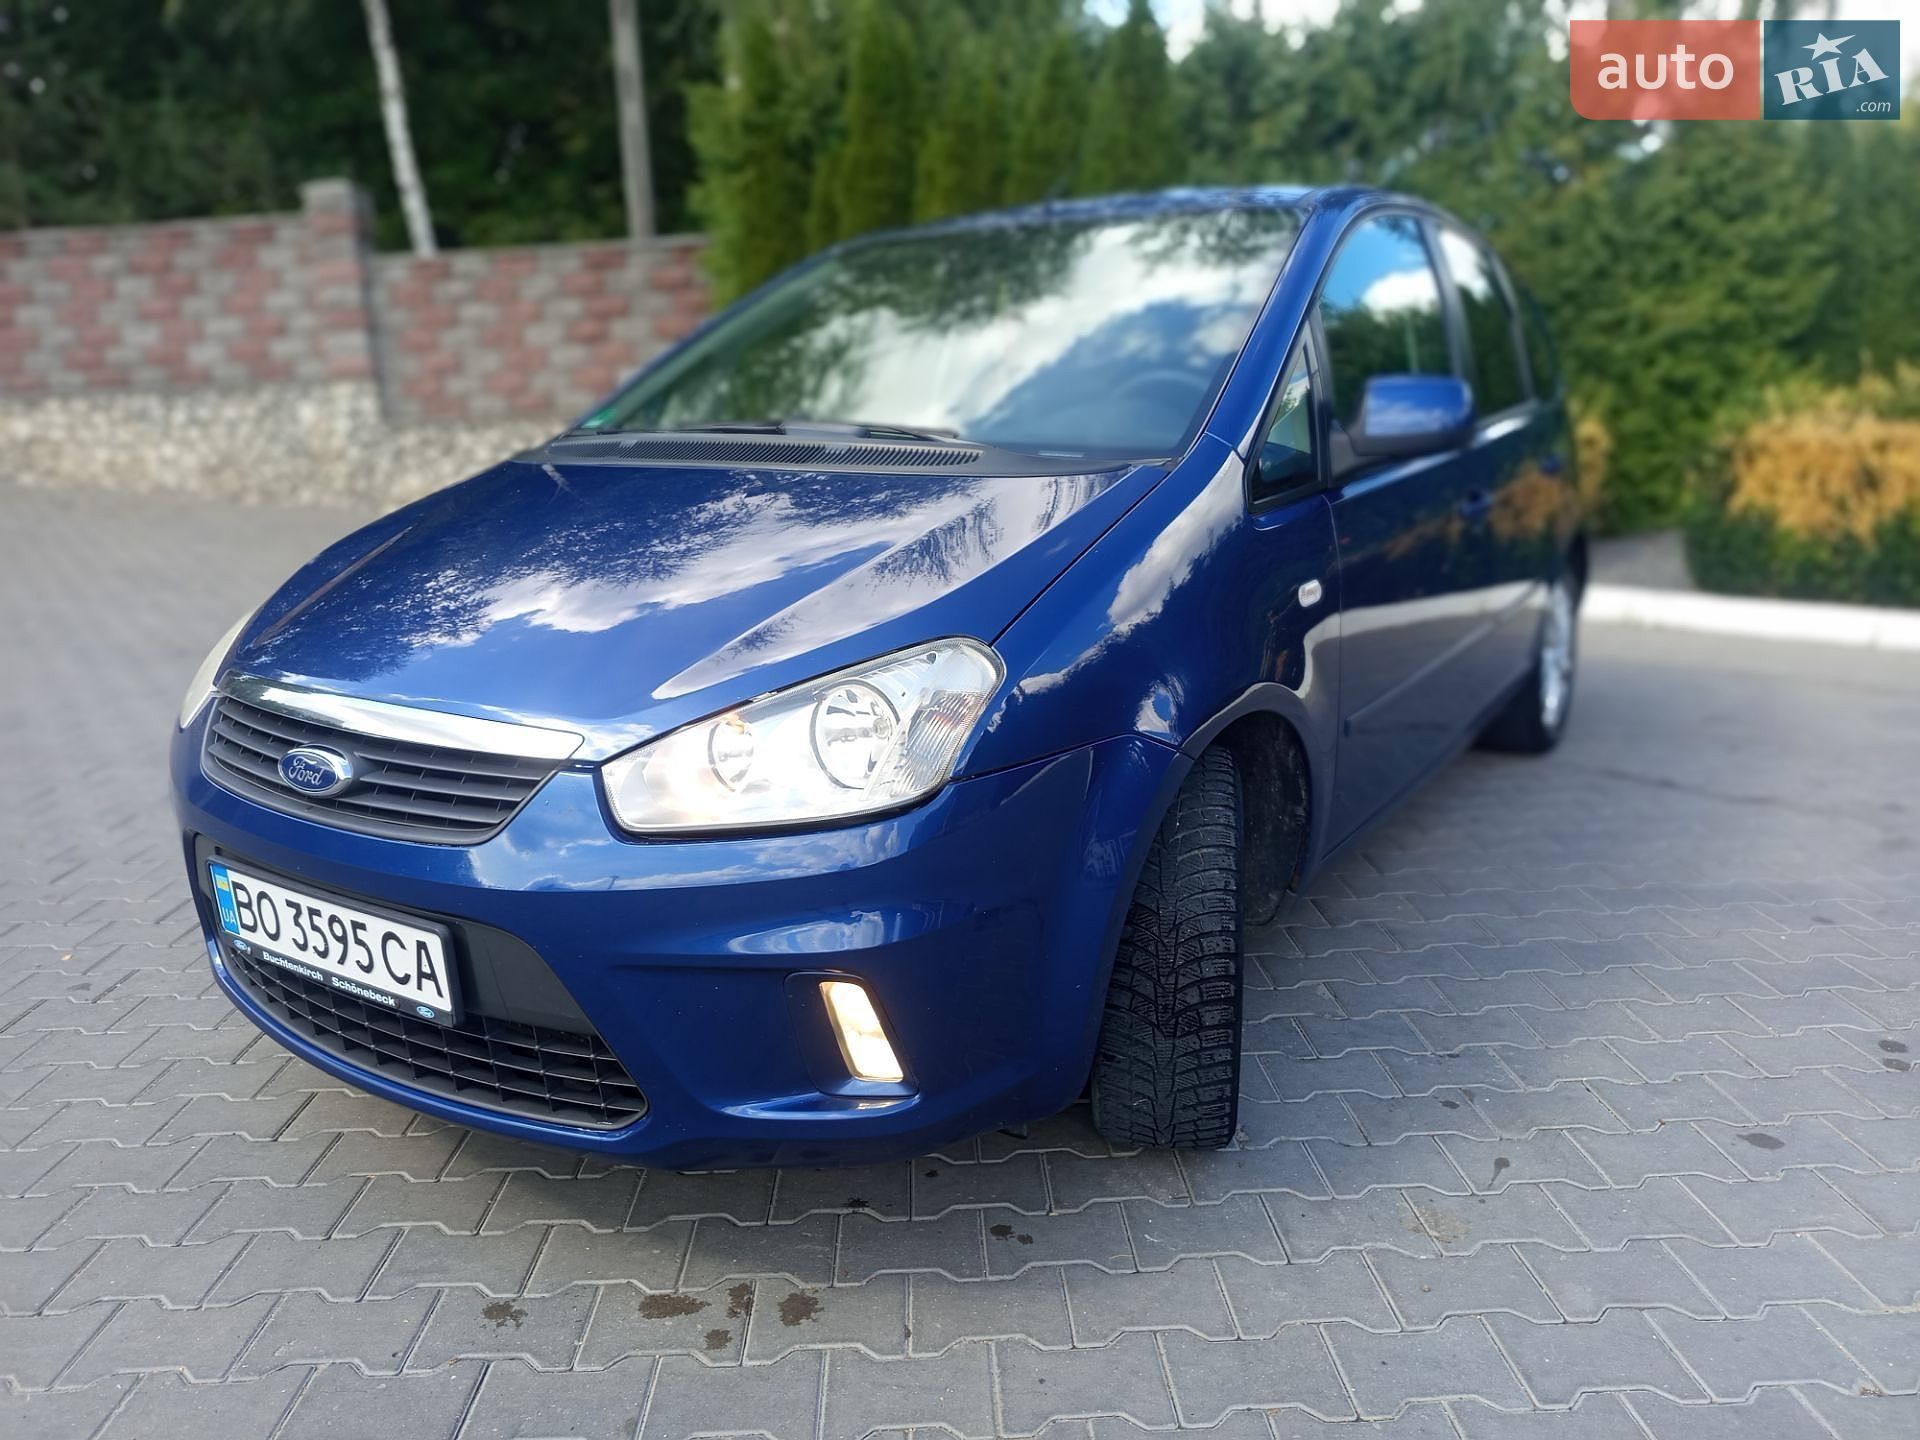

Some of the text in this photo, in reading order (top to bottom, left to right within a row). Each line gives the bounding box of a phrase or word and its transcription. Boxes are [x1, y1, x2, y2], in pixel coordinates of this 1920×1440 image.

[288, 756, 324, 786] Ford
[221, 907, 237, 926] UA
[231, 880, 444, 998] BO 3595 CA
[262, 951, 396, 1007] Buchtenkirch Schönebeck
